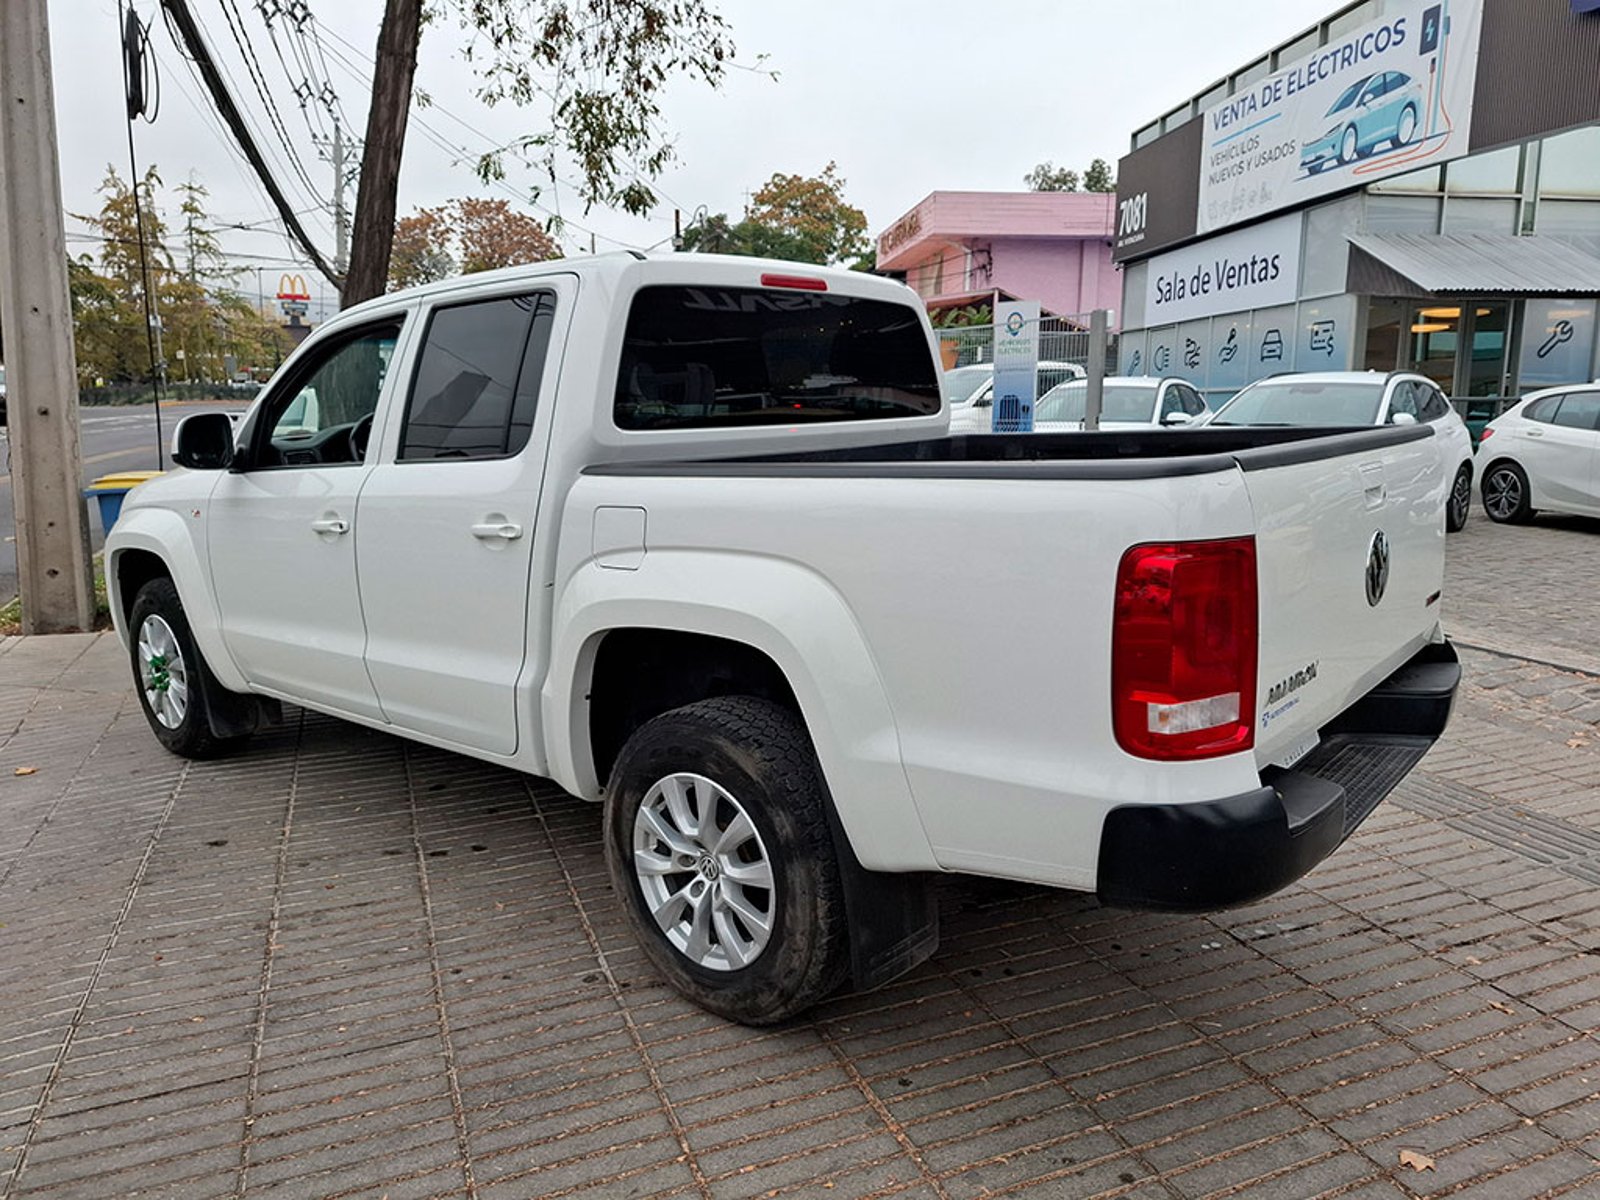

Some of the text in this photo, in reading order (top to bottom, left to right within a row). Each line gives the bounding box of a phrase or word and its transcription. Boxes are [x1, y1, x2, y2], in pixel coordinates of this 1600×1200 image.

[1213, 17, 1406, 131] VENTA DE ELÉCTRICOS
[1208, 160, 1245, 186] NUEVOS
[1254, 139, 1296, 168] USADOS
[1118, 191, 1148, 237] 7081
[1155, 254, 1280, 304] Sala de Ventas
